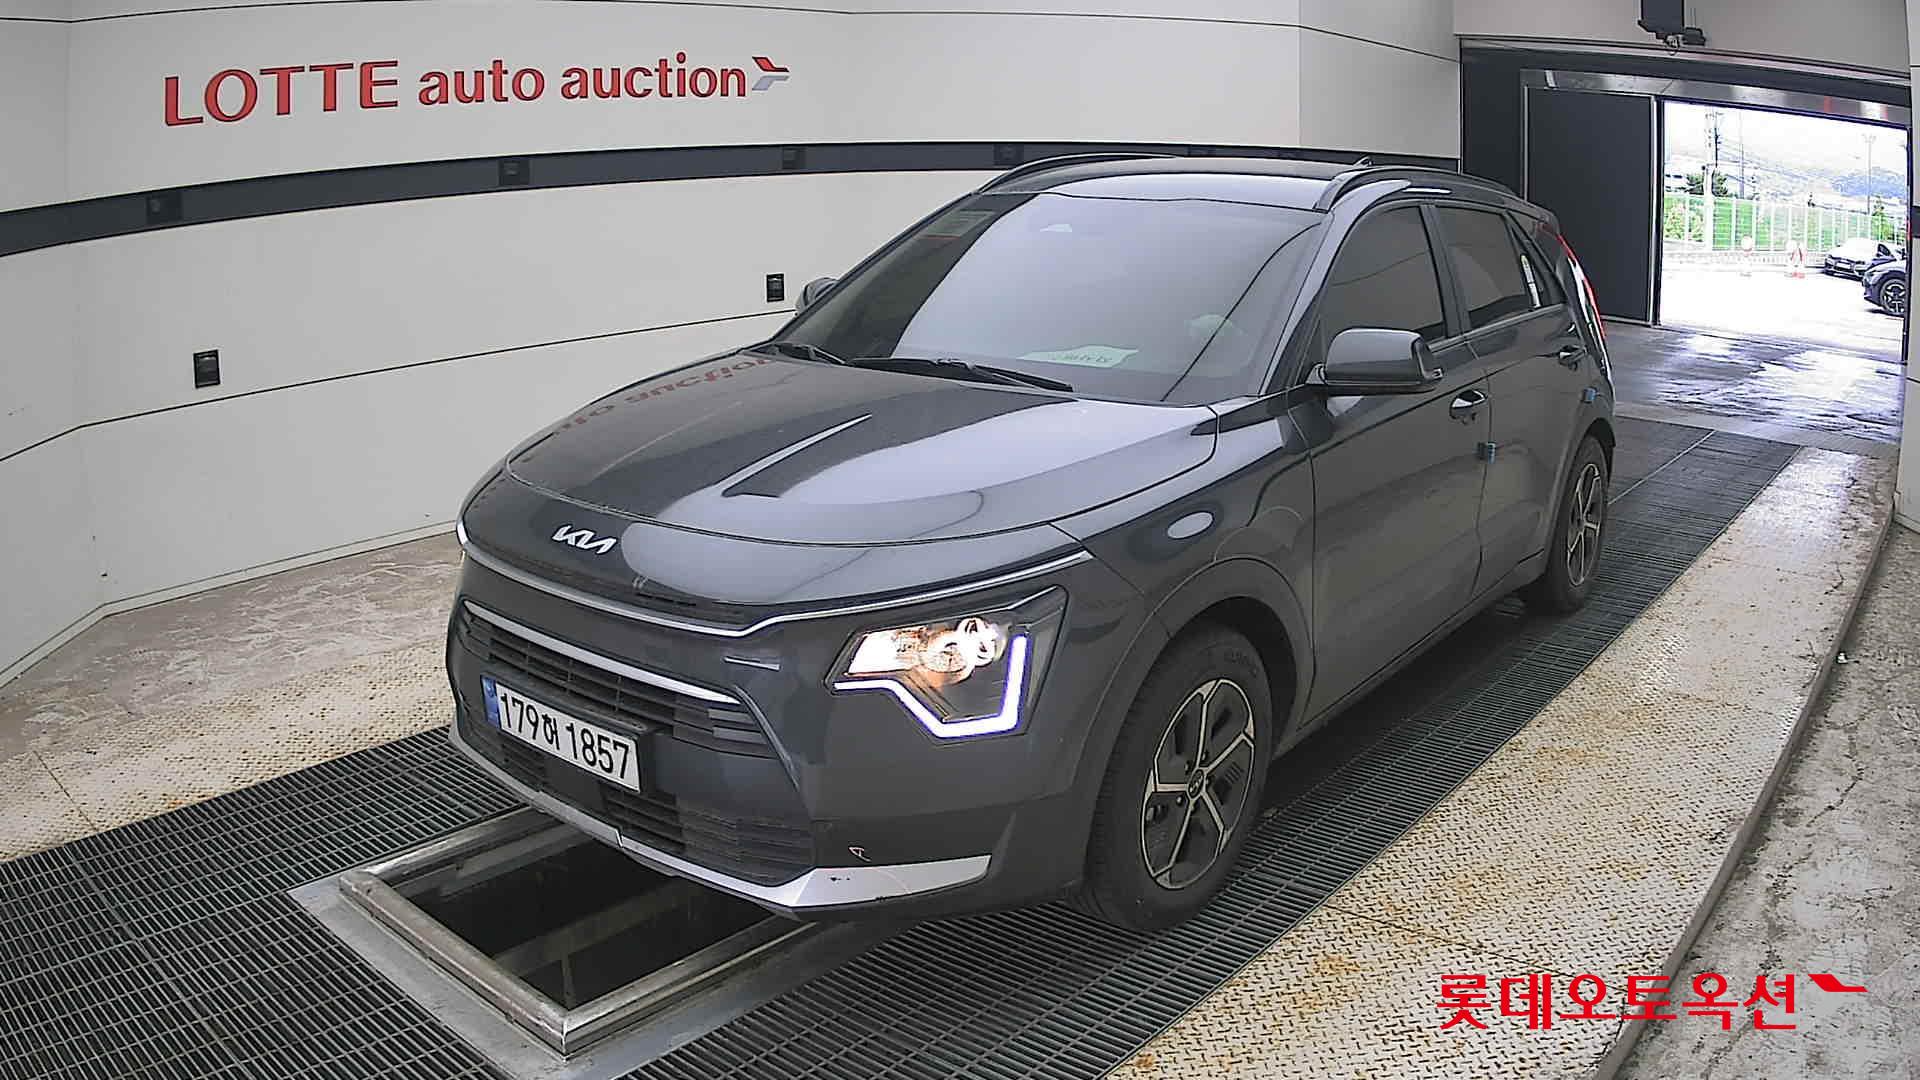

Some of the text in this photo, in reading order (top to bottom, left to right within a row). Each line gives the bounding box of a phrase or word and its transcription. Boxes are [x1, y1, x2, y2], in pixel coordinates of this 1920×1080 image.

[164, 51, 747, 127] LOTTE auto auction
[500, 692, 630, 780] 179허 1857
